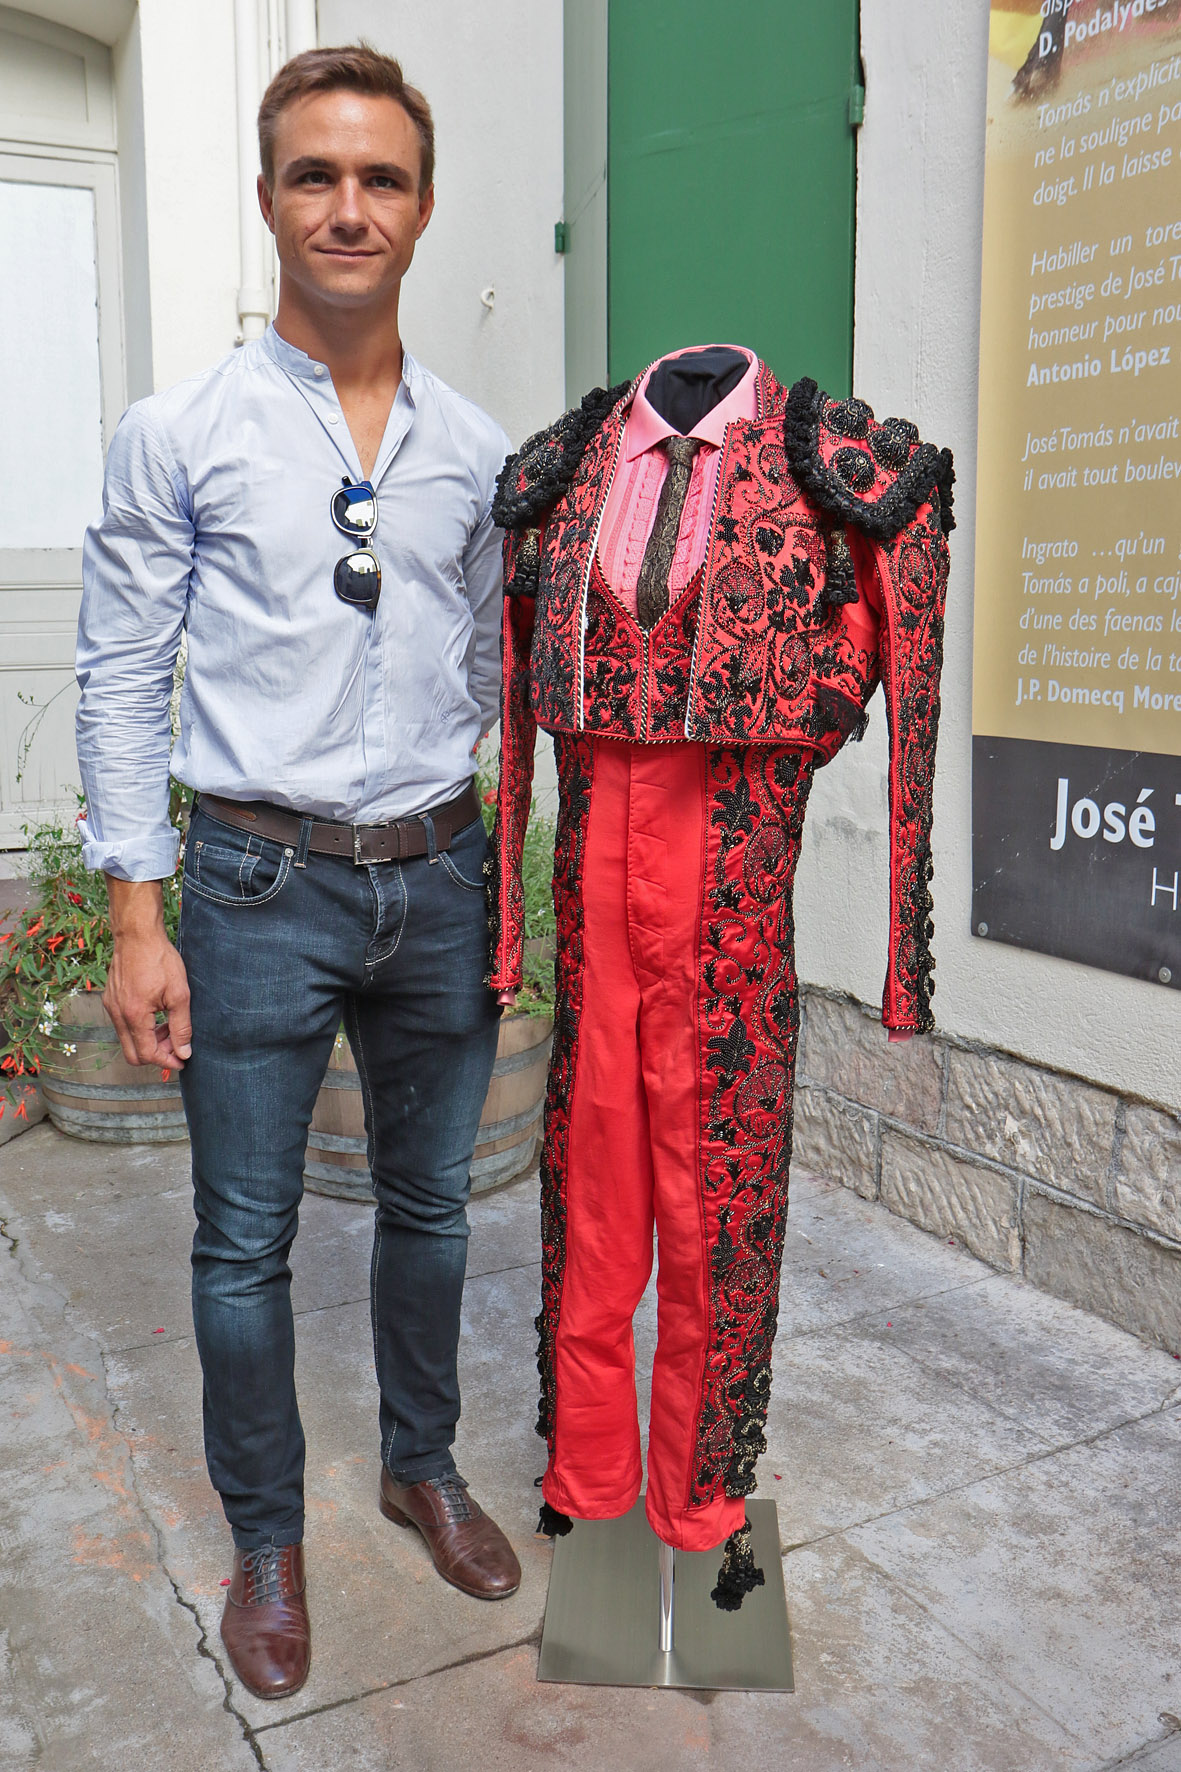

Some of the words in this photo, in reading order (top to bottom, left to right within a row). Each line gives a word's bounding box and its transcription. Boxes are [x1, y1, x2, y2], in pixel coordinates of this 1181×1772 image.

[1039, 0, 1082, 18] disp
[1039, 31, 1057, 58] D.
[1037, 91, 1092, 129] Tomás
[1034, 145, 1055, 169] ne
[1060, 135, 1075, 160] la
[1079, 112, 1152, 153] souligne
[1033, 176, 1078, 206] doigt.
[1098, 161, 1116, 186] la
[1121, 146, 1172, 179] laisse
[1030, 239, 1099, 277] Habiller
[1109, 234, 1133, 257] un
[1145, 220, 1181, 248] tore
[1028, 281, 1095, 321] prestige
[1100, 271, 1122, 297] de
[1123, 258, 1165, 300] José
[1168, 253, 1181, 281] T
[1028, 320, 1099, 350] honneur
[1103, 311, 1147, 343] pour
[1026, 353, 1102, 387] Antonio
[1110, 345, 1171, 377] López
[1021, 429, 1058, 462] José
[1059, 423, 1114, 451] Tomás
[1118, 415, 1180, 445] n'avait
[1023, 468, 1034, 492] il
[1038, 466, 1078, 490] avait
[1083, 464, 1118, 486] tout
[1021, 536, 1079, 564] Ingrato
[1021, 571, 1072, 594] Tomás
[1078, 577, 1090, 594] a
[1094, 570, 1131, 601] poli,
[1135, 576, 1148, 594] a
[1153, 570, 1181, 601] caj
[1019, 607, 1063, 630] d'une
[1068, 607, 1098, 631] des
[1103, 608, 1164, 637] faenas
[1018, 643, 1037, 665] de
[1042, 643, 1111, 669] l'histoire
[1117, 646, 1140, 671] de
[1145, 647, 1162, 671] la
[1015, 677, 1042, 706] J.P.
[1047, 679, 1125, 714] Domecq
[1133, 684, 1181, 713] More
[1049, 777, 1156, 851] José
